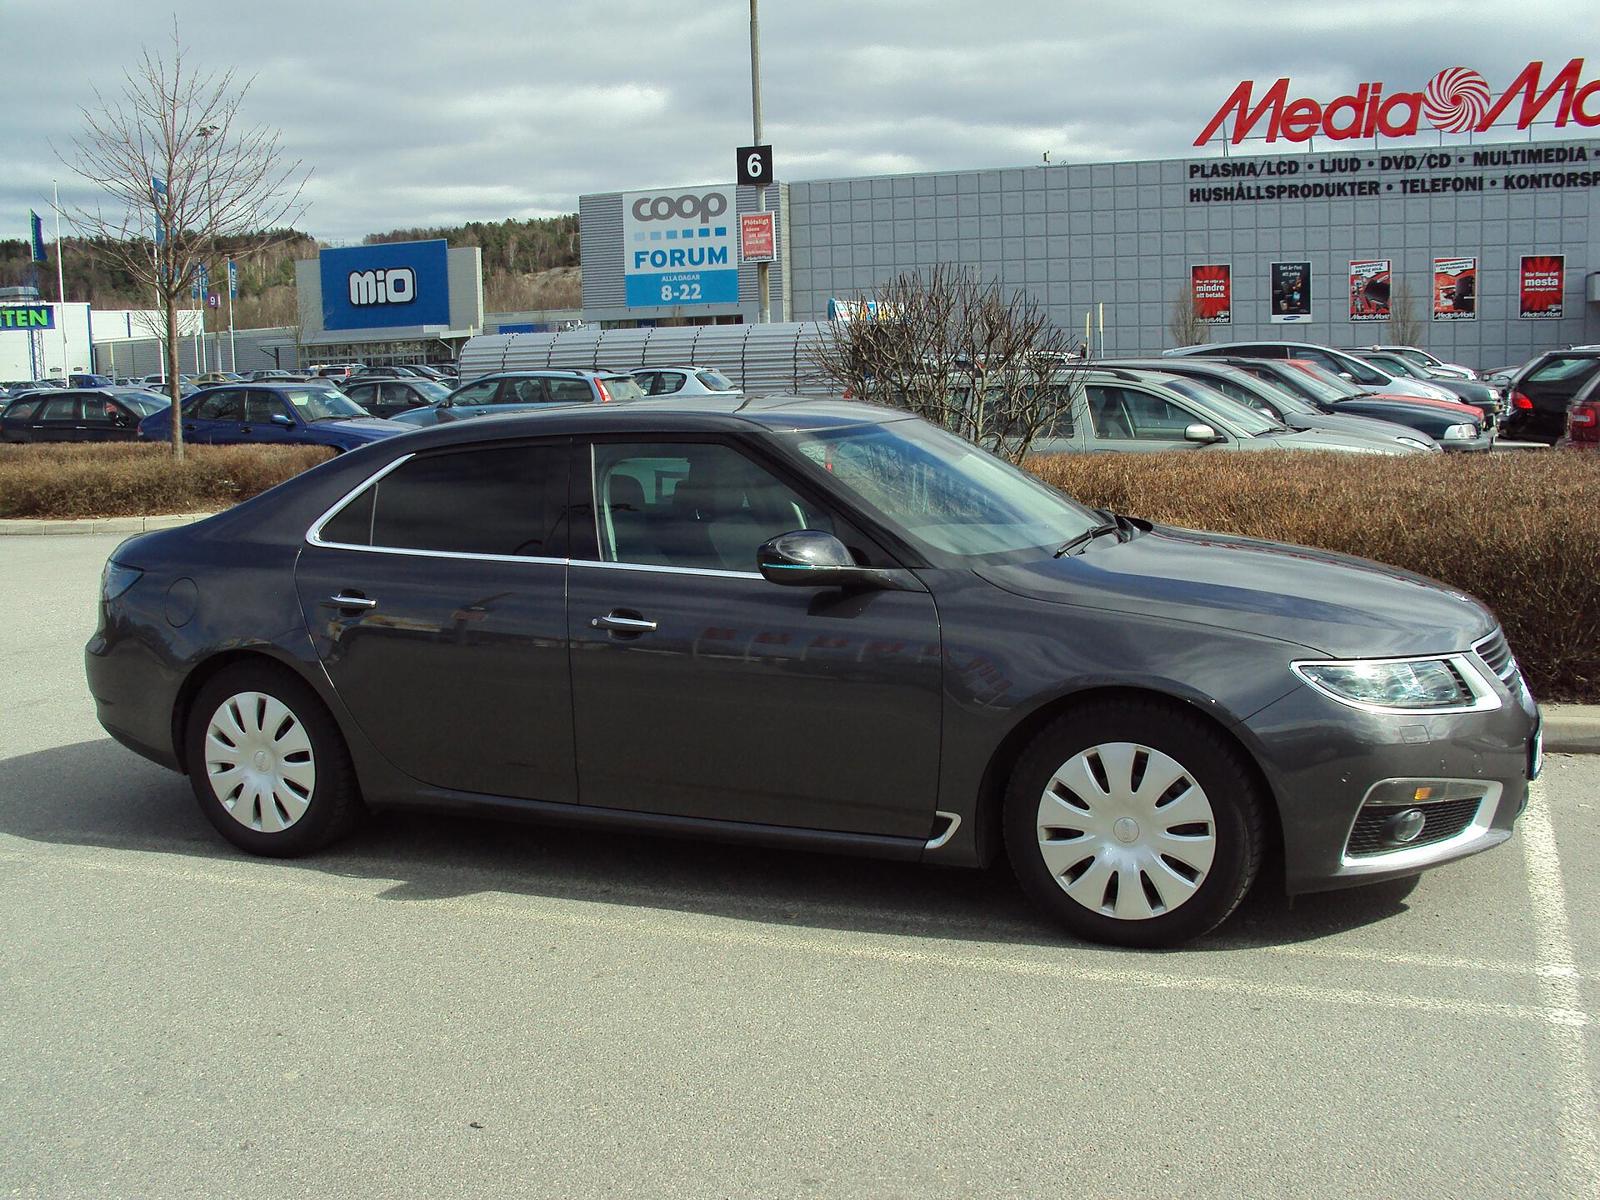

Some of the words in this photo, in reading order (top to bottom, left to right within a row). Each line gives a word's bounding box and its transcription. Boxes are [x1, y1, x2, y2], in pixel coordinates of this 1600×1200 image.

[1193, 78, 1424, 146] Media
[747, 153, 762, 177] 6
[1189, 160, 1299, 178] PLASMA/LCD
[1320, 157, 1361, 173] LJUD
[1381, 153, 1451, 170] DVD/CD
[1473, 147, 1587, 166] MULTIMEDIA
[1190, 181, 1380, 202] HUSHÅLLSPRODUKTER
[1400, 175, 1483, 194] TELEFONI
[634, 246, 728, 269] FORUM
[661, 284, 701, 301] 8-22
[1525, 277, 1558, 286] mesta
[210, 296, 216, 305] 9
[0, 309, 48, 328] TEN
